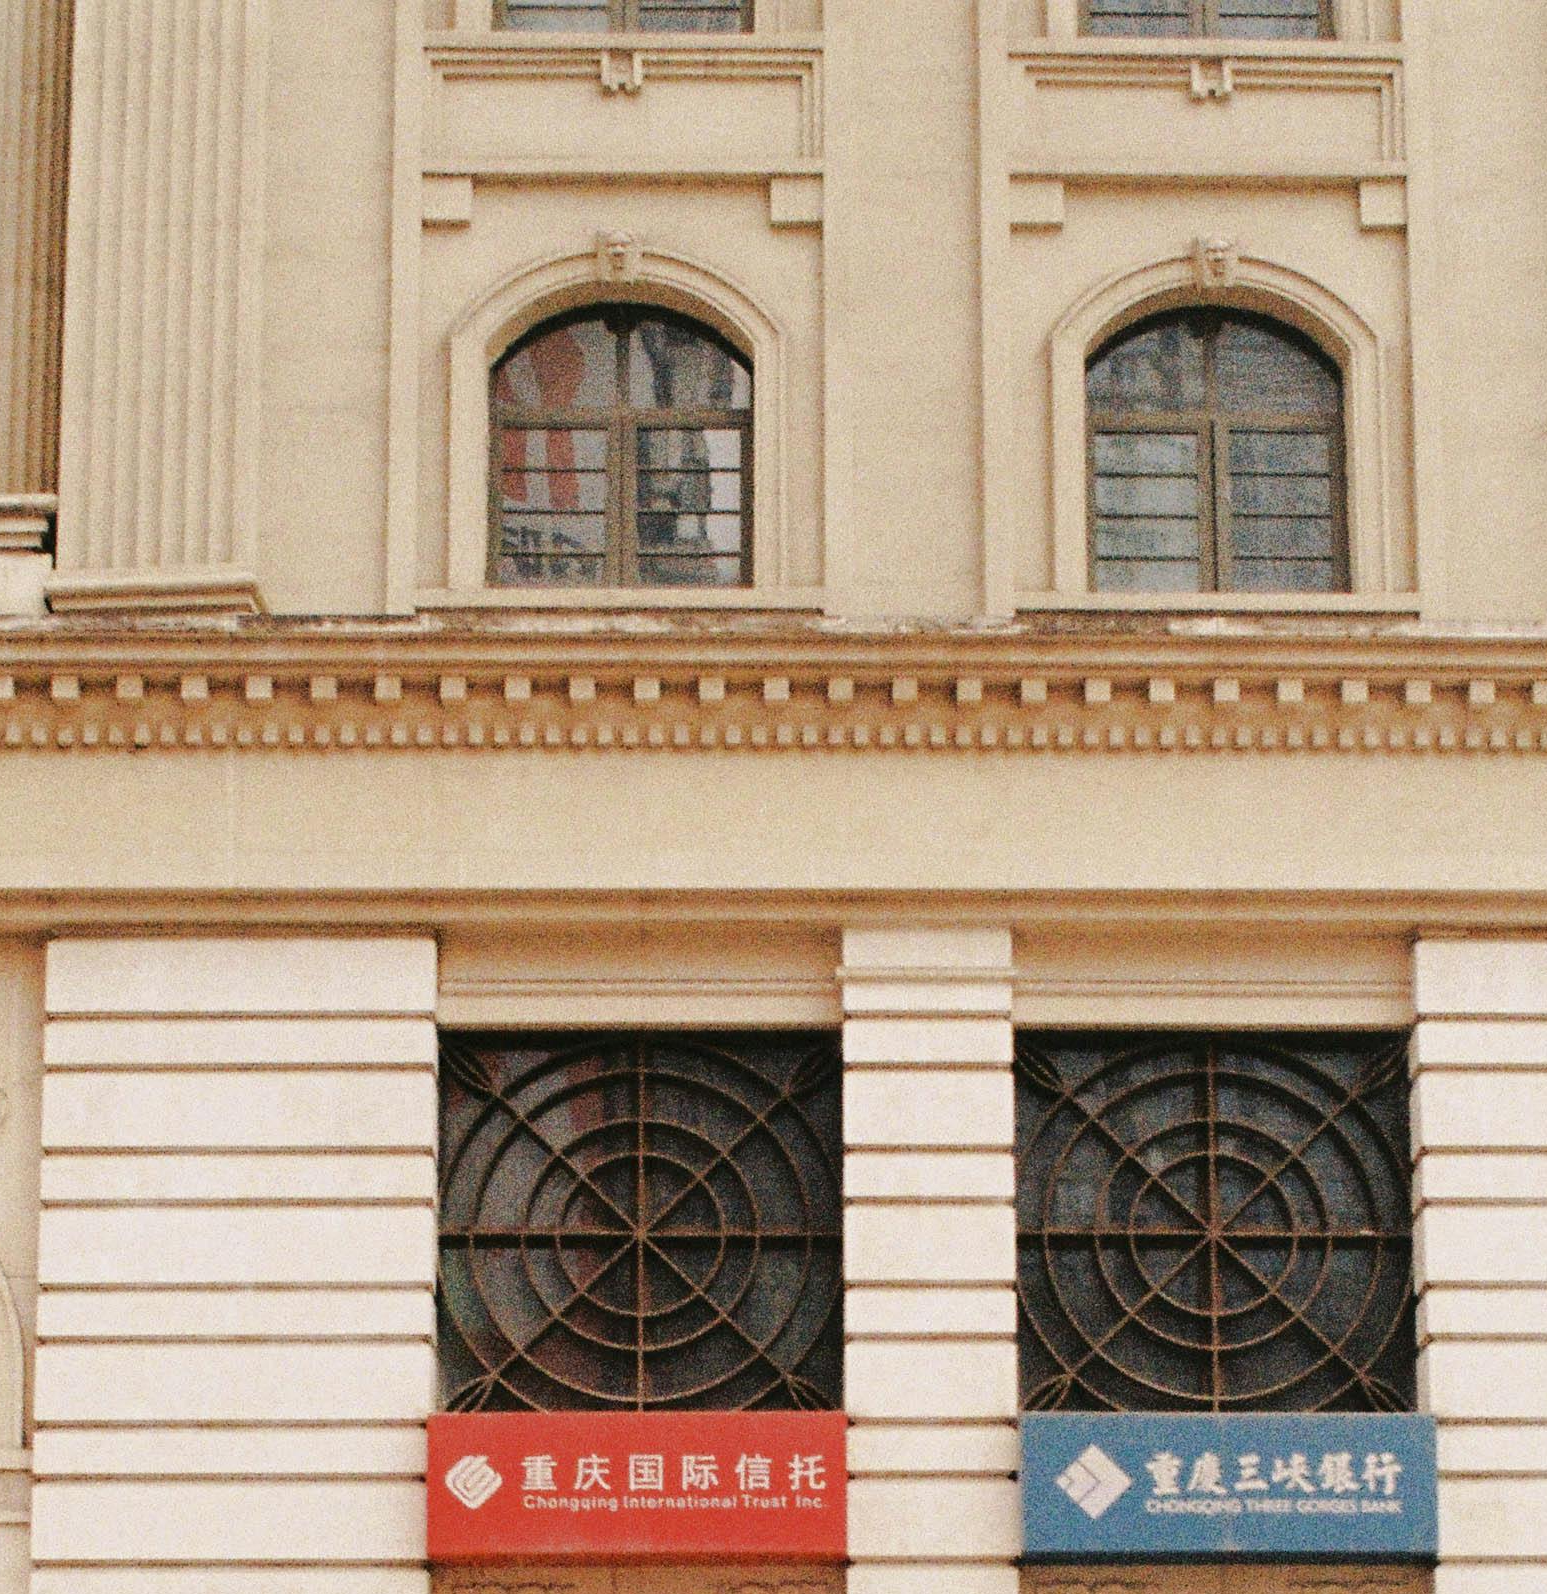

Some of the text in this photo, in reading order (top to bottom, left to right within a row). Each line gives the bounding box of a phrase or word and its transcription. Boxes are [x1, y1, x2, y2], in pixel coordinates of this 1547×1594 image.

[521, 1454, 827, 1491] 重庆国际信托
[523, 1494, 828, 1511] Chongqing International Trust Inc.
[1146, 1499, 1403, 1516] CHONGQING THREE GORGES BANK
